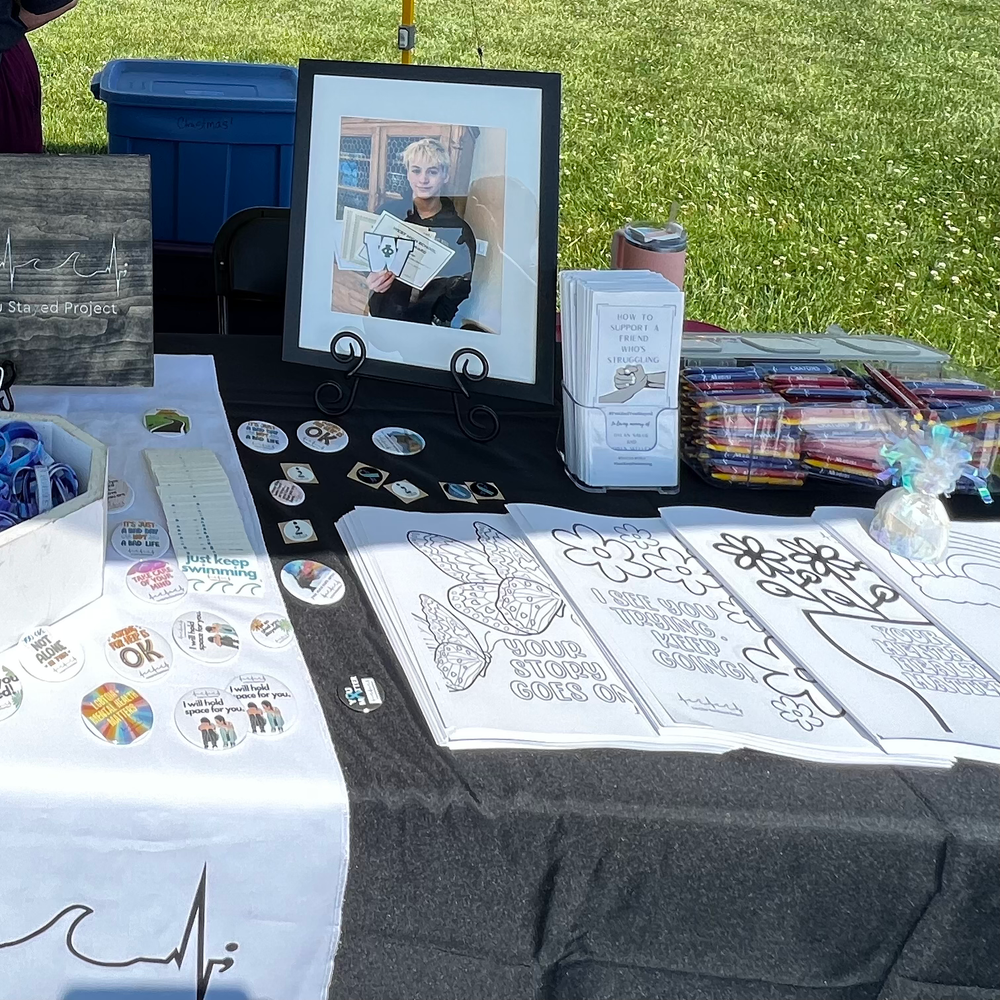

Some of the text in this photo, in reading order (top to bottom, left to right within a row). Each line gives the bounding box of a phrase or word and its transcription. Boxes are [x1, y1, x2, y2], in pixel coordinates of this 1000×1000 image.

[65, 300, 118, 318] Project
[617, 313, 654, 321] HOW TO
[610, 324, 648, 332] SUPPORT
[618, 334, 649, 342] FRIEND
[607, 356, 660, 364] STRUGGLING
[304, 426, 338, 446] OK
[185, 551, 250, 570] just keep
[132, 566, 173, 583] TAKE CARE
[140, 573, 174, 587] OF YOUR
[181, 564, 258, 581] swimming
[149, 580, 172, 591] MIND
[590, 587, 719, 621] I SEE YOU
[186, 620, 195, 634] hold
[870, 624, 952, 646] YOUR
[30, 634, 53, 652] NOT
[35, 639, 68, 664] ALONE
[503, 638, 587, 659] YOUR
[650, 629, 721, 658] KEEP
[871, 638, 973, 662] MENTA
[119, 638, 165, 669] OK
[509, 659, 607, 682] STORY
[651, 648, 759, 684] GOING!
[889, 655, 991, 680] HEALT
[229, 683, 270, 693] I will hold
[510, 679, 635, 704] GOES ON
[900, 671, 1000, 698] MATTE
[182, 698, 225, 708] I will hold
[232, 692, 257, 700] pace
[88, 689, 140, 726] MENTAL HEALTH
[106, 702, 139, 727] MATTERS
[185, 707, 210, 716] space
